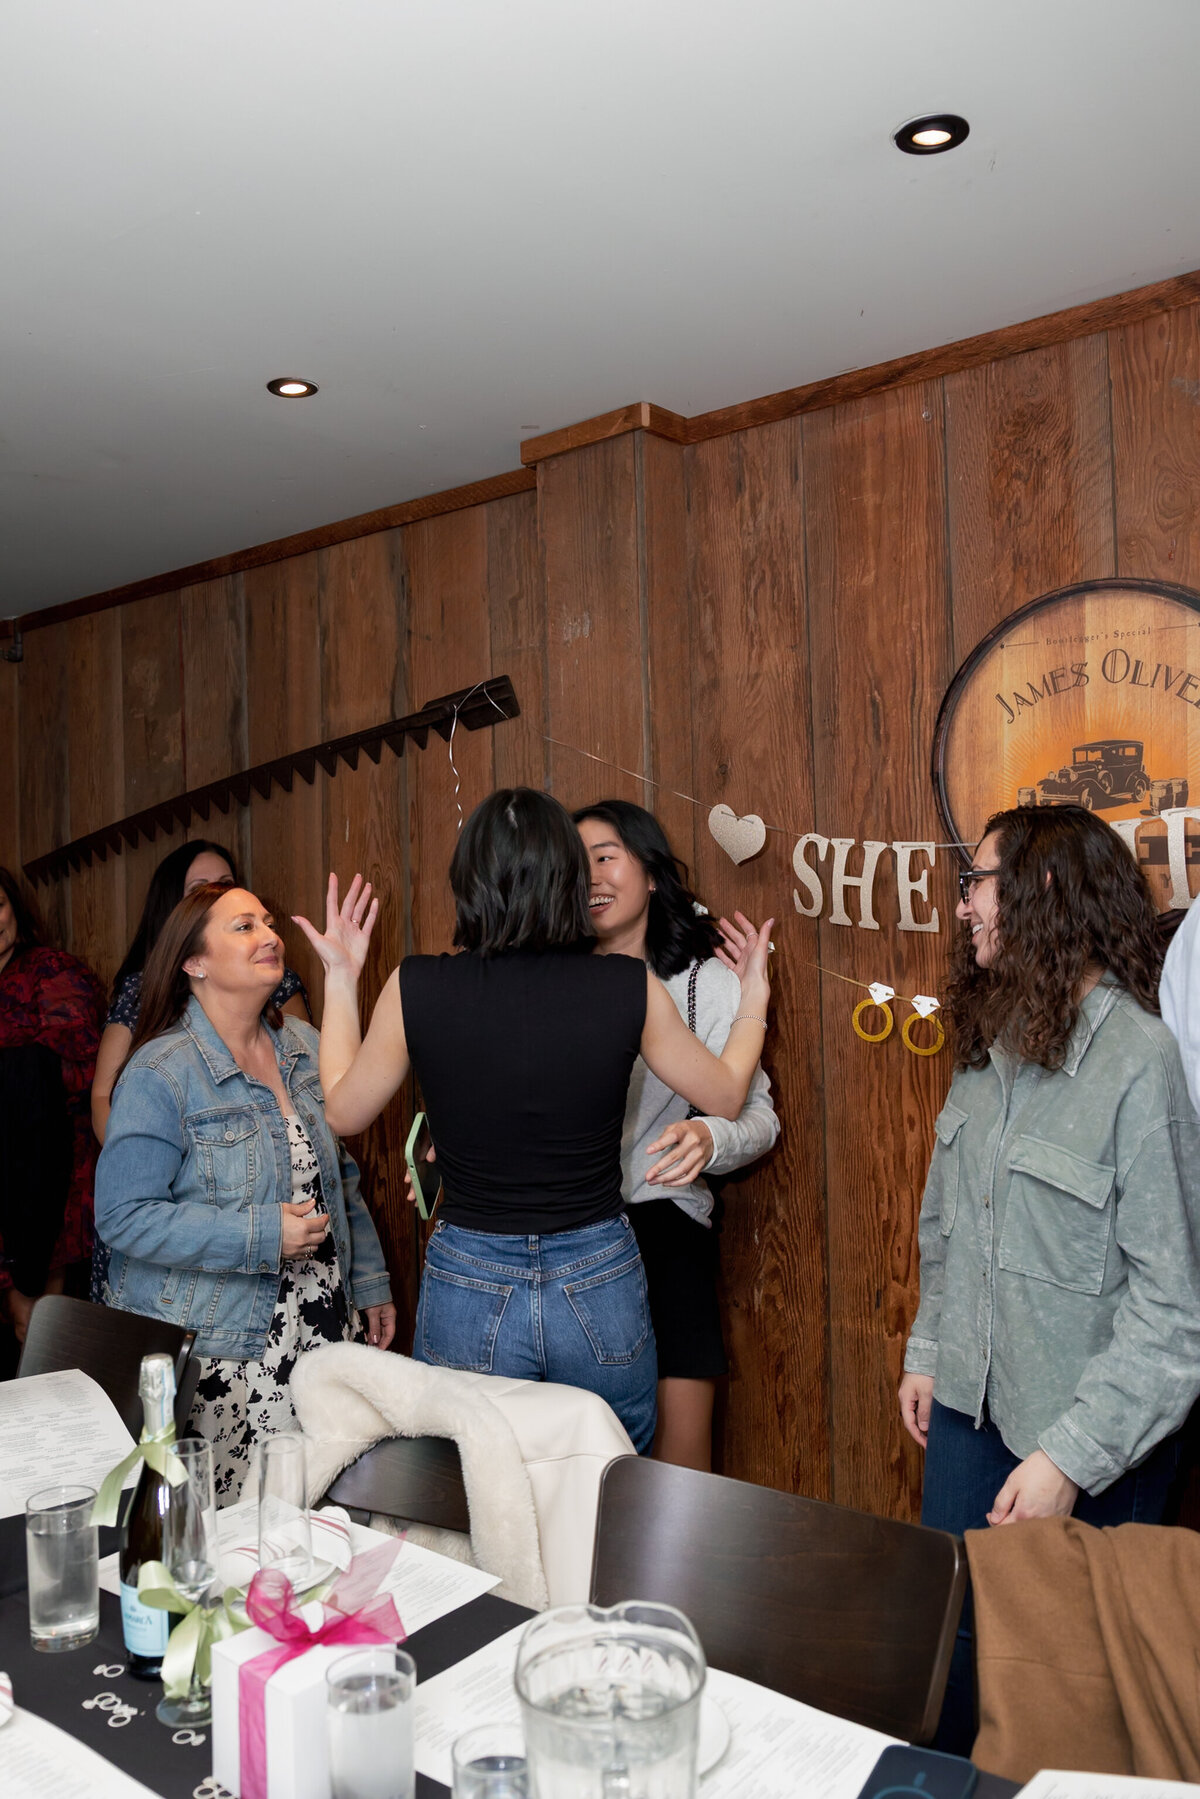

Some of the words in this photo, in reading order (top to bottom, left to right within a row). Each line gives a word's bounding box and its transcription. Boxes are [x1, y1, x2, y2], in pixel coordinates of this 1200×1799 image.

[1112, 627, 1151, 640] Special
[995, 662, 1090, 724] JAMES
[1101, 648, 1200, 710] OLIVE
[792, 832, 940, 933] SHE
